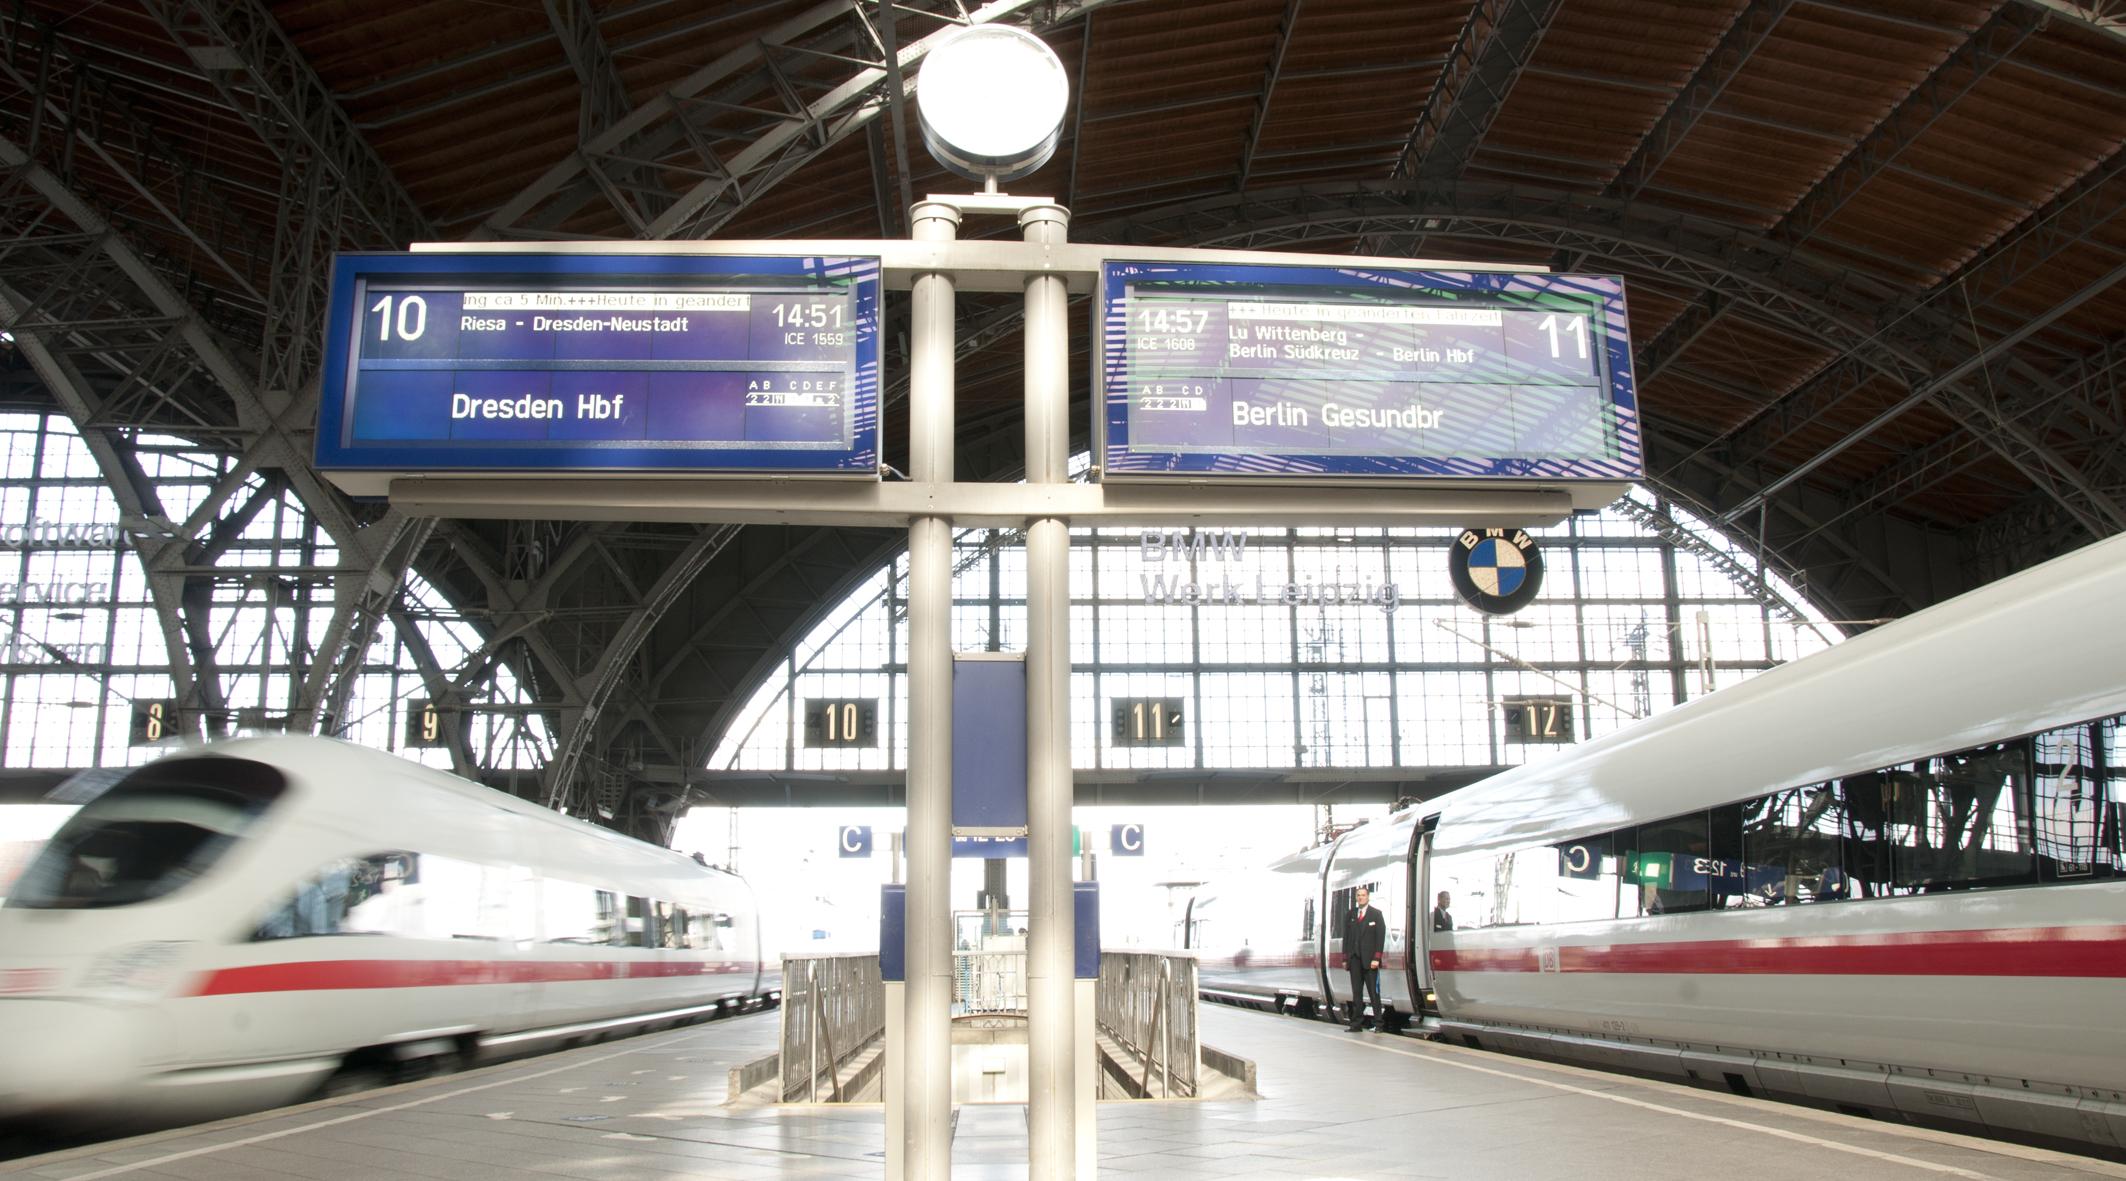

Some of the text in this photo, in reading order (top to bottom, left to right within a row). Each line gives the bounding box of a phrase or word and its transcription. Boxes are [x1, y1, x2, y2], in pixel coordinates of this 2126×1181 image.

[494, 296, 513, 306] ca
[520, 293, 529, 306] 5
[371, 295, 428, 341] 10
[460, 316, 506, 331] Riesa
[533, 316, 689, 332] Dresden-Neustadt
[772, 303, 842, 328] 14:51
[1138, 309, 1209, 334] 14:57
[784, 332, 844, 346] ICE 1559
[1137, 337, 1158, 350] ICE
[1228, 325, 1249, 340] Lu
[1255, 325, 1348, 346] Wittenberg
[1538, 314, 1587, 359] 11
[1229, 343, 1278, 359] Berlin
[1283, 344, 1360, 361] Südkreuz
[1392, 347, 1441, 363] Berlin
[1446, 348, 1475, 363] Hbf
[748, 380, 838, 391] A B C D E F
[1142, 386, 1204, 396] A B C D
[451, 393, 625, 419] Dresden Hbf
[1232, 401, 1444, 429] Berlin Gesundbr
[1139, 530, 1248, 562] BMW
[1458, 528, 1533, 550] BMW
[1140, 573, 1400, 613] Werk Leipzig
[148, 703, 163, 741] 8
[422, 703, 438, 741] 9
[826, 703, 857, 741] 10
[1134, 702, 1162, 741] 11
[1527, 704, 1557, 737] 12
[2056, 738, 2079, 791] 2
[842, 825, 862, 852] C
[1121, 823, 1141, 850] C
